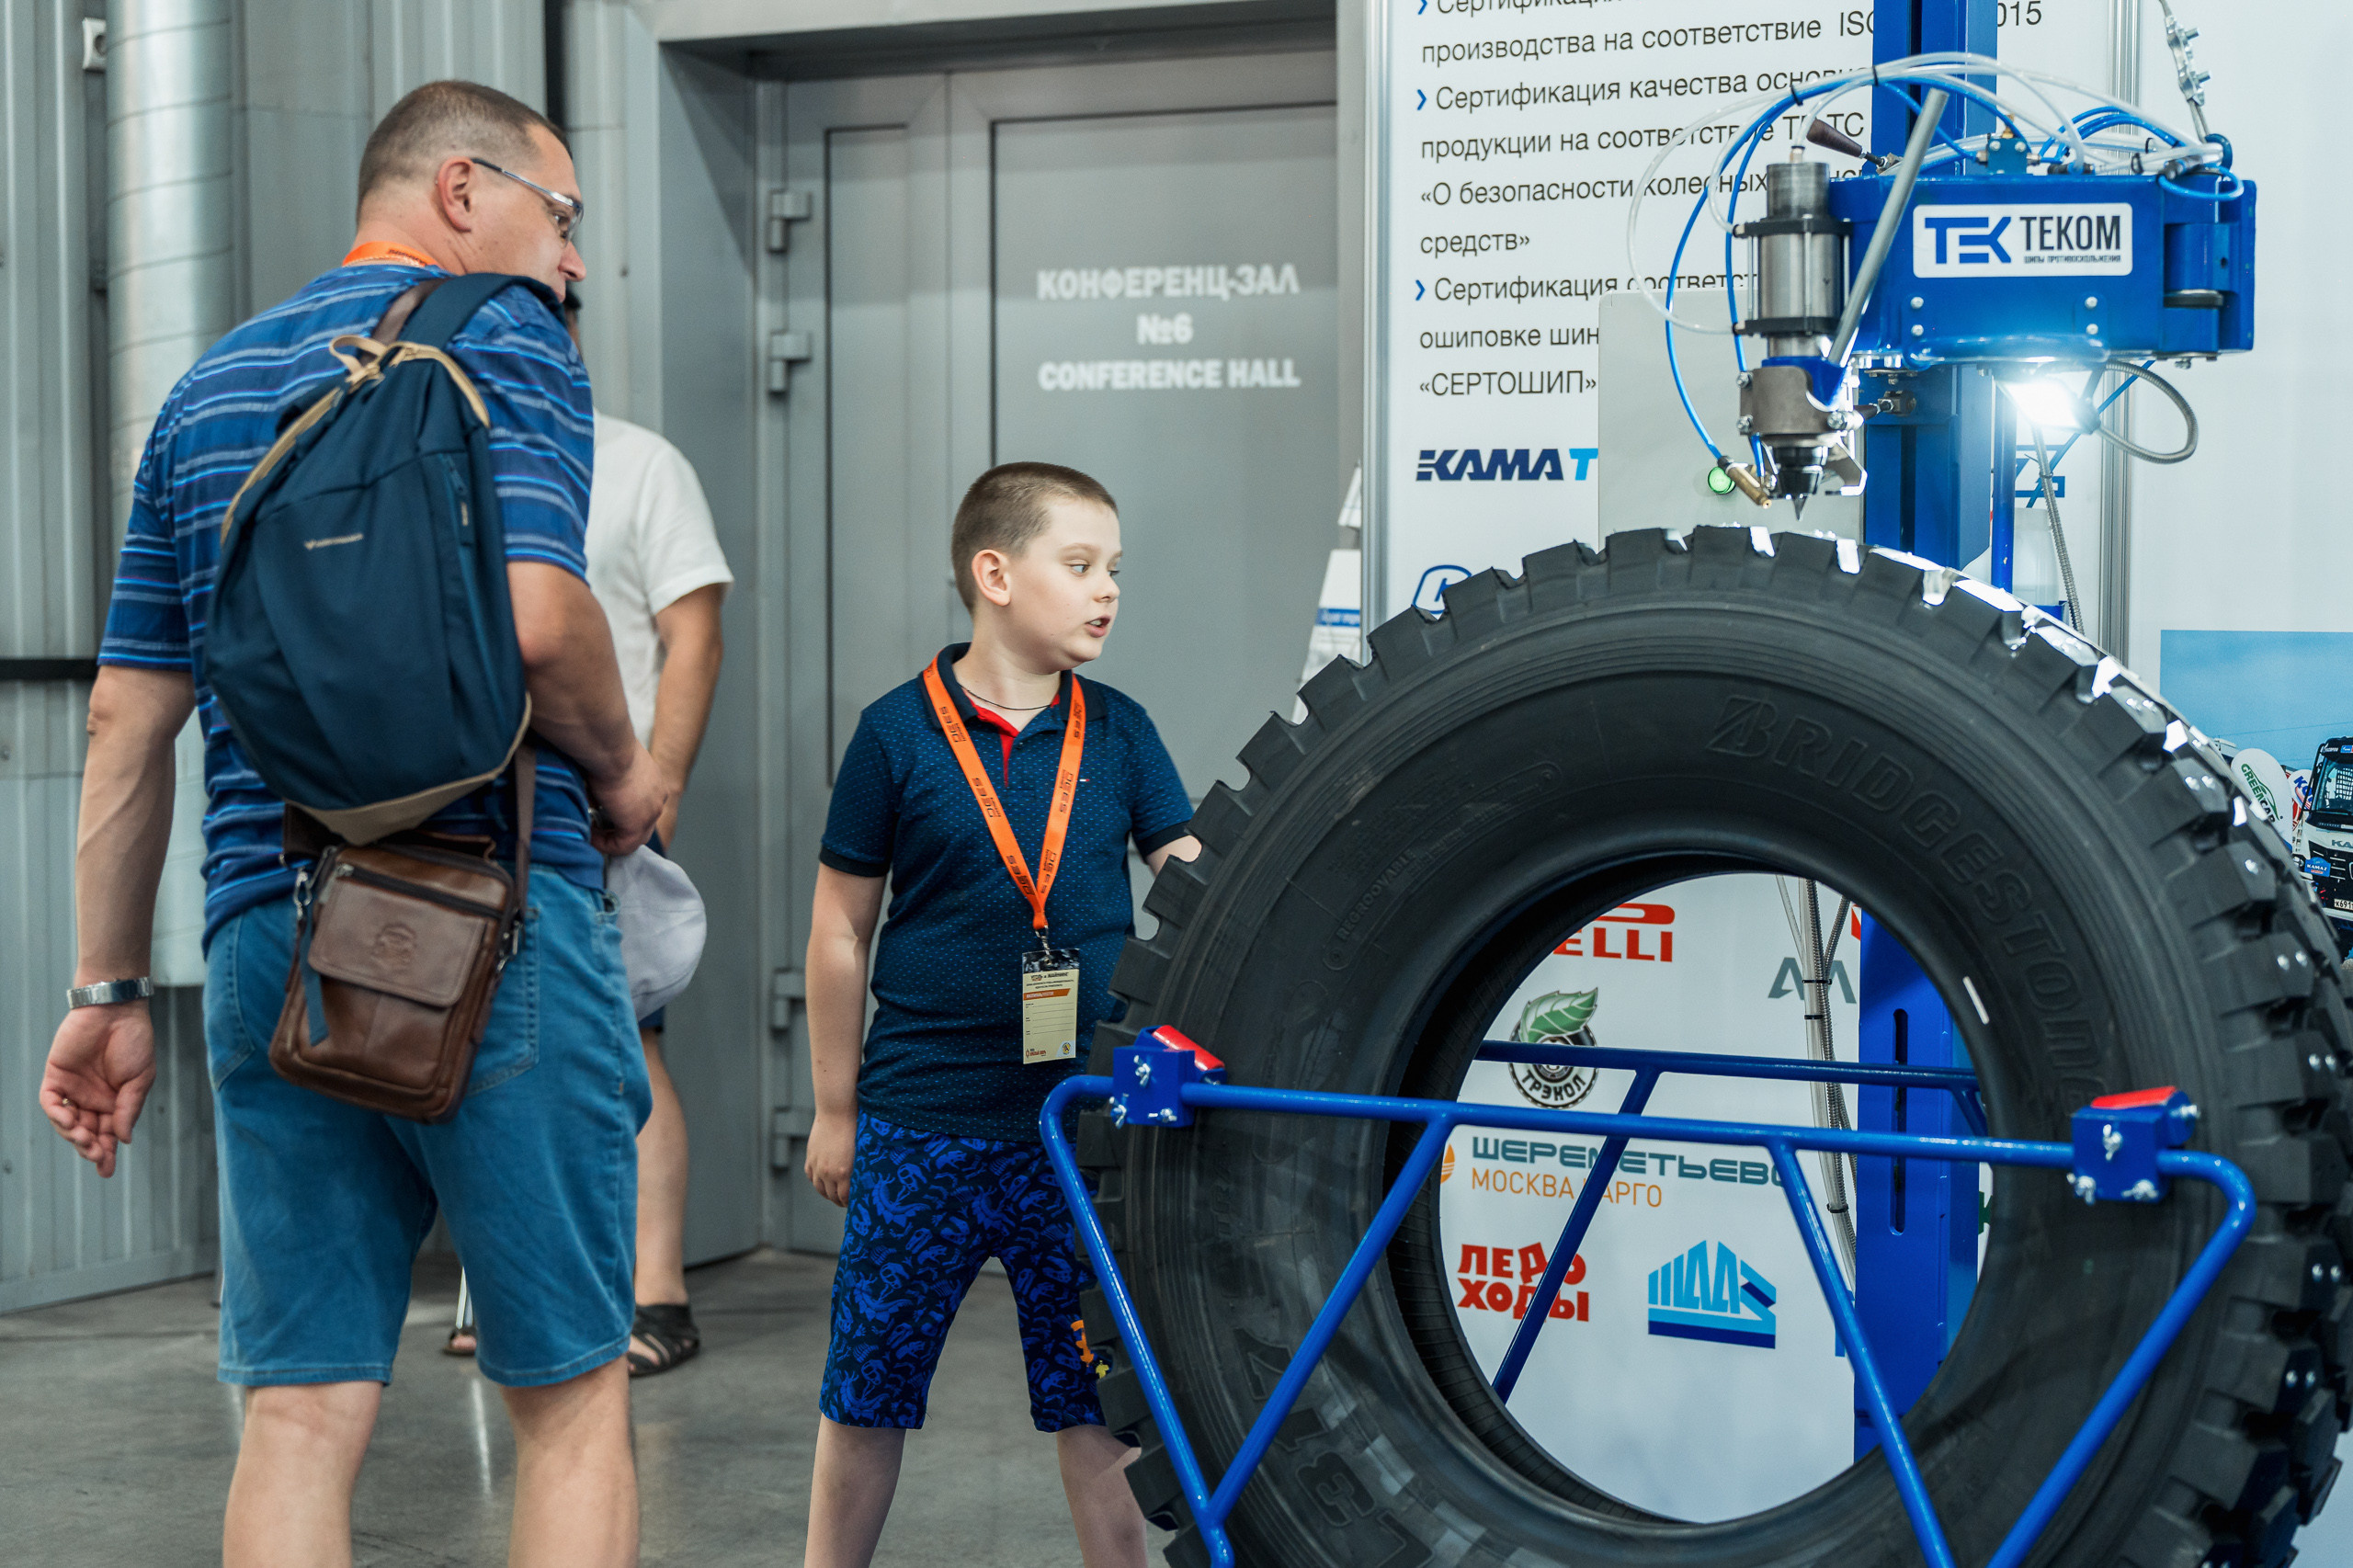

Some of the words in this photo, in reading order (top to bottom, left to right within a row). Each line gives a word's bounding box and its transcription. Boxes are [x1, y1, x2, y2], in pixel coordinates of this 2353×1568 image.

[1438, 0, 1623, 17] Сертиф
[1423, 34, 1596, 68] производства
[1605, 31, 1633, 51] на
[1642, 19, 1822, 49] соответствие
[1839, 10, 1874, 37] IS
[1437, 82, 1620, 114] Сертификация
[1630, 74, 1747, 99] качества
[1421, 134, 1552, 164] продукции
[1561, 131, 1589, 152] на
[1597, 121, 1774, 150] соотвесте
[1421, 182, 1451, 206] «О
[1460, 179, 1633, 204] безопасности
[1420, 233, 1530, 259] средств»
[1037, 263, 1301, 301] КОНФЕРЕНЦ-ЗАЛ
[1434, 275, 1619, 305] Сертификация
[1137, 312, 1194, 345] №6
[1420, 327, 1541, 349] ошиповке
[1038, 359, 1222, 391] CONFERENCE
[1228, 358, 1301, 389] HALL
[1419, 369, 1597, 396] «СЕРТОШИП»
[1415, 449, 1564, 482] KAMA
[1522, 1069, 1586, 1102] ТРЭКОЛ
[1472, 1167, 1574, 1199] МОСКВА
[1583, 1176, 1662, 1208] АРГО
